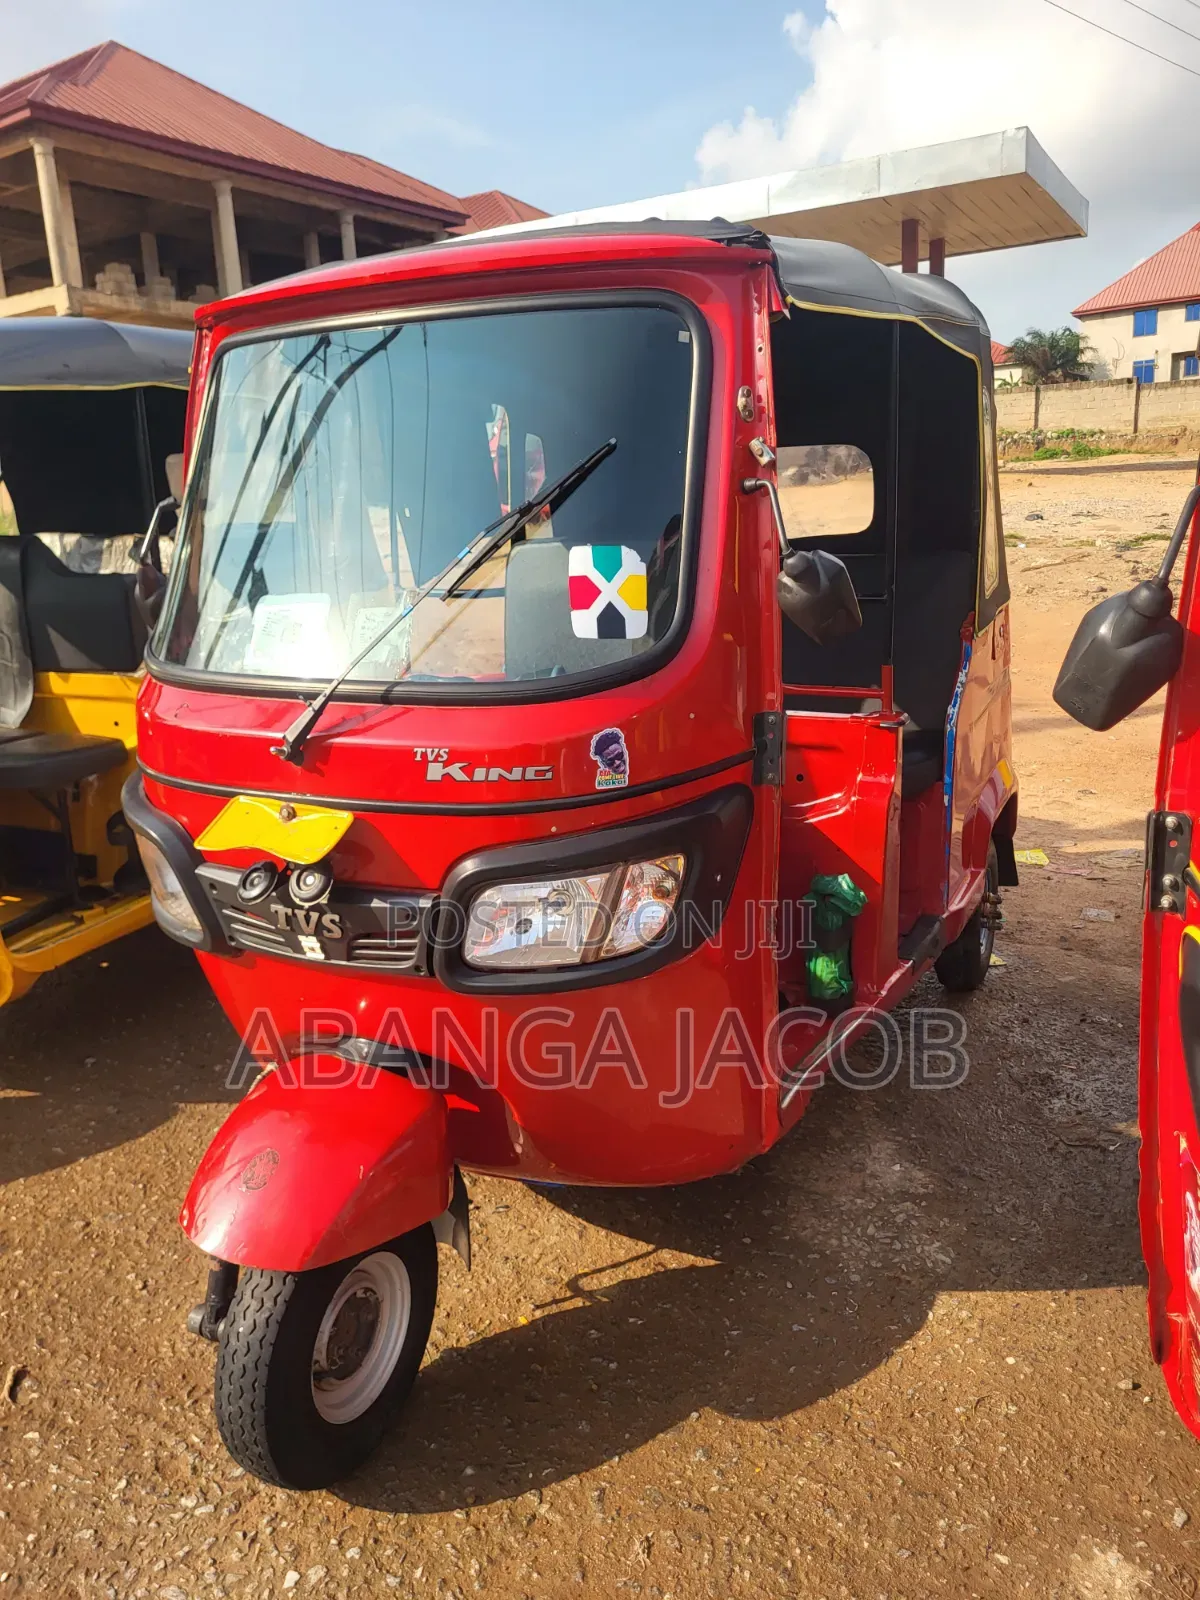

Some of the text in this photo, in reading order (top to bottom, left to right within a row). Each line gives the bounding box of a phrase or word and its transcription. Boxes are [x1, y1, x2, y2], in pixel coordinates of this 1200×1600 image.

[414, 748, 449, 761] TVS
[426, 762, 555, 782] KING
[270, 904, 343, 938] TVS
